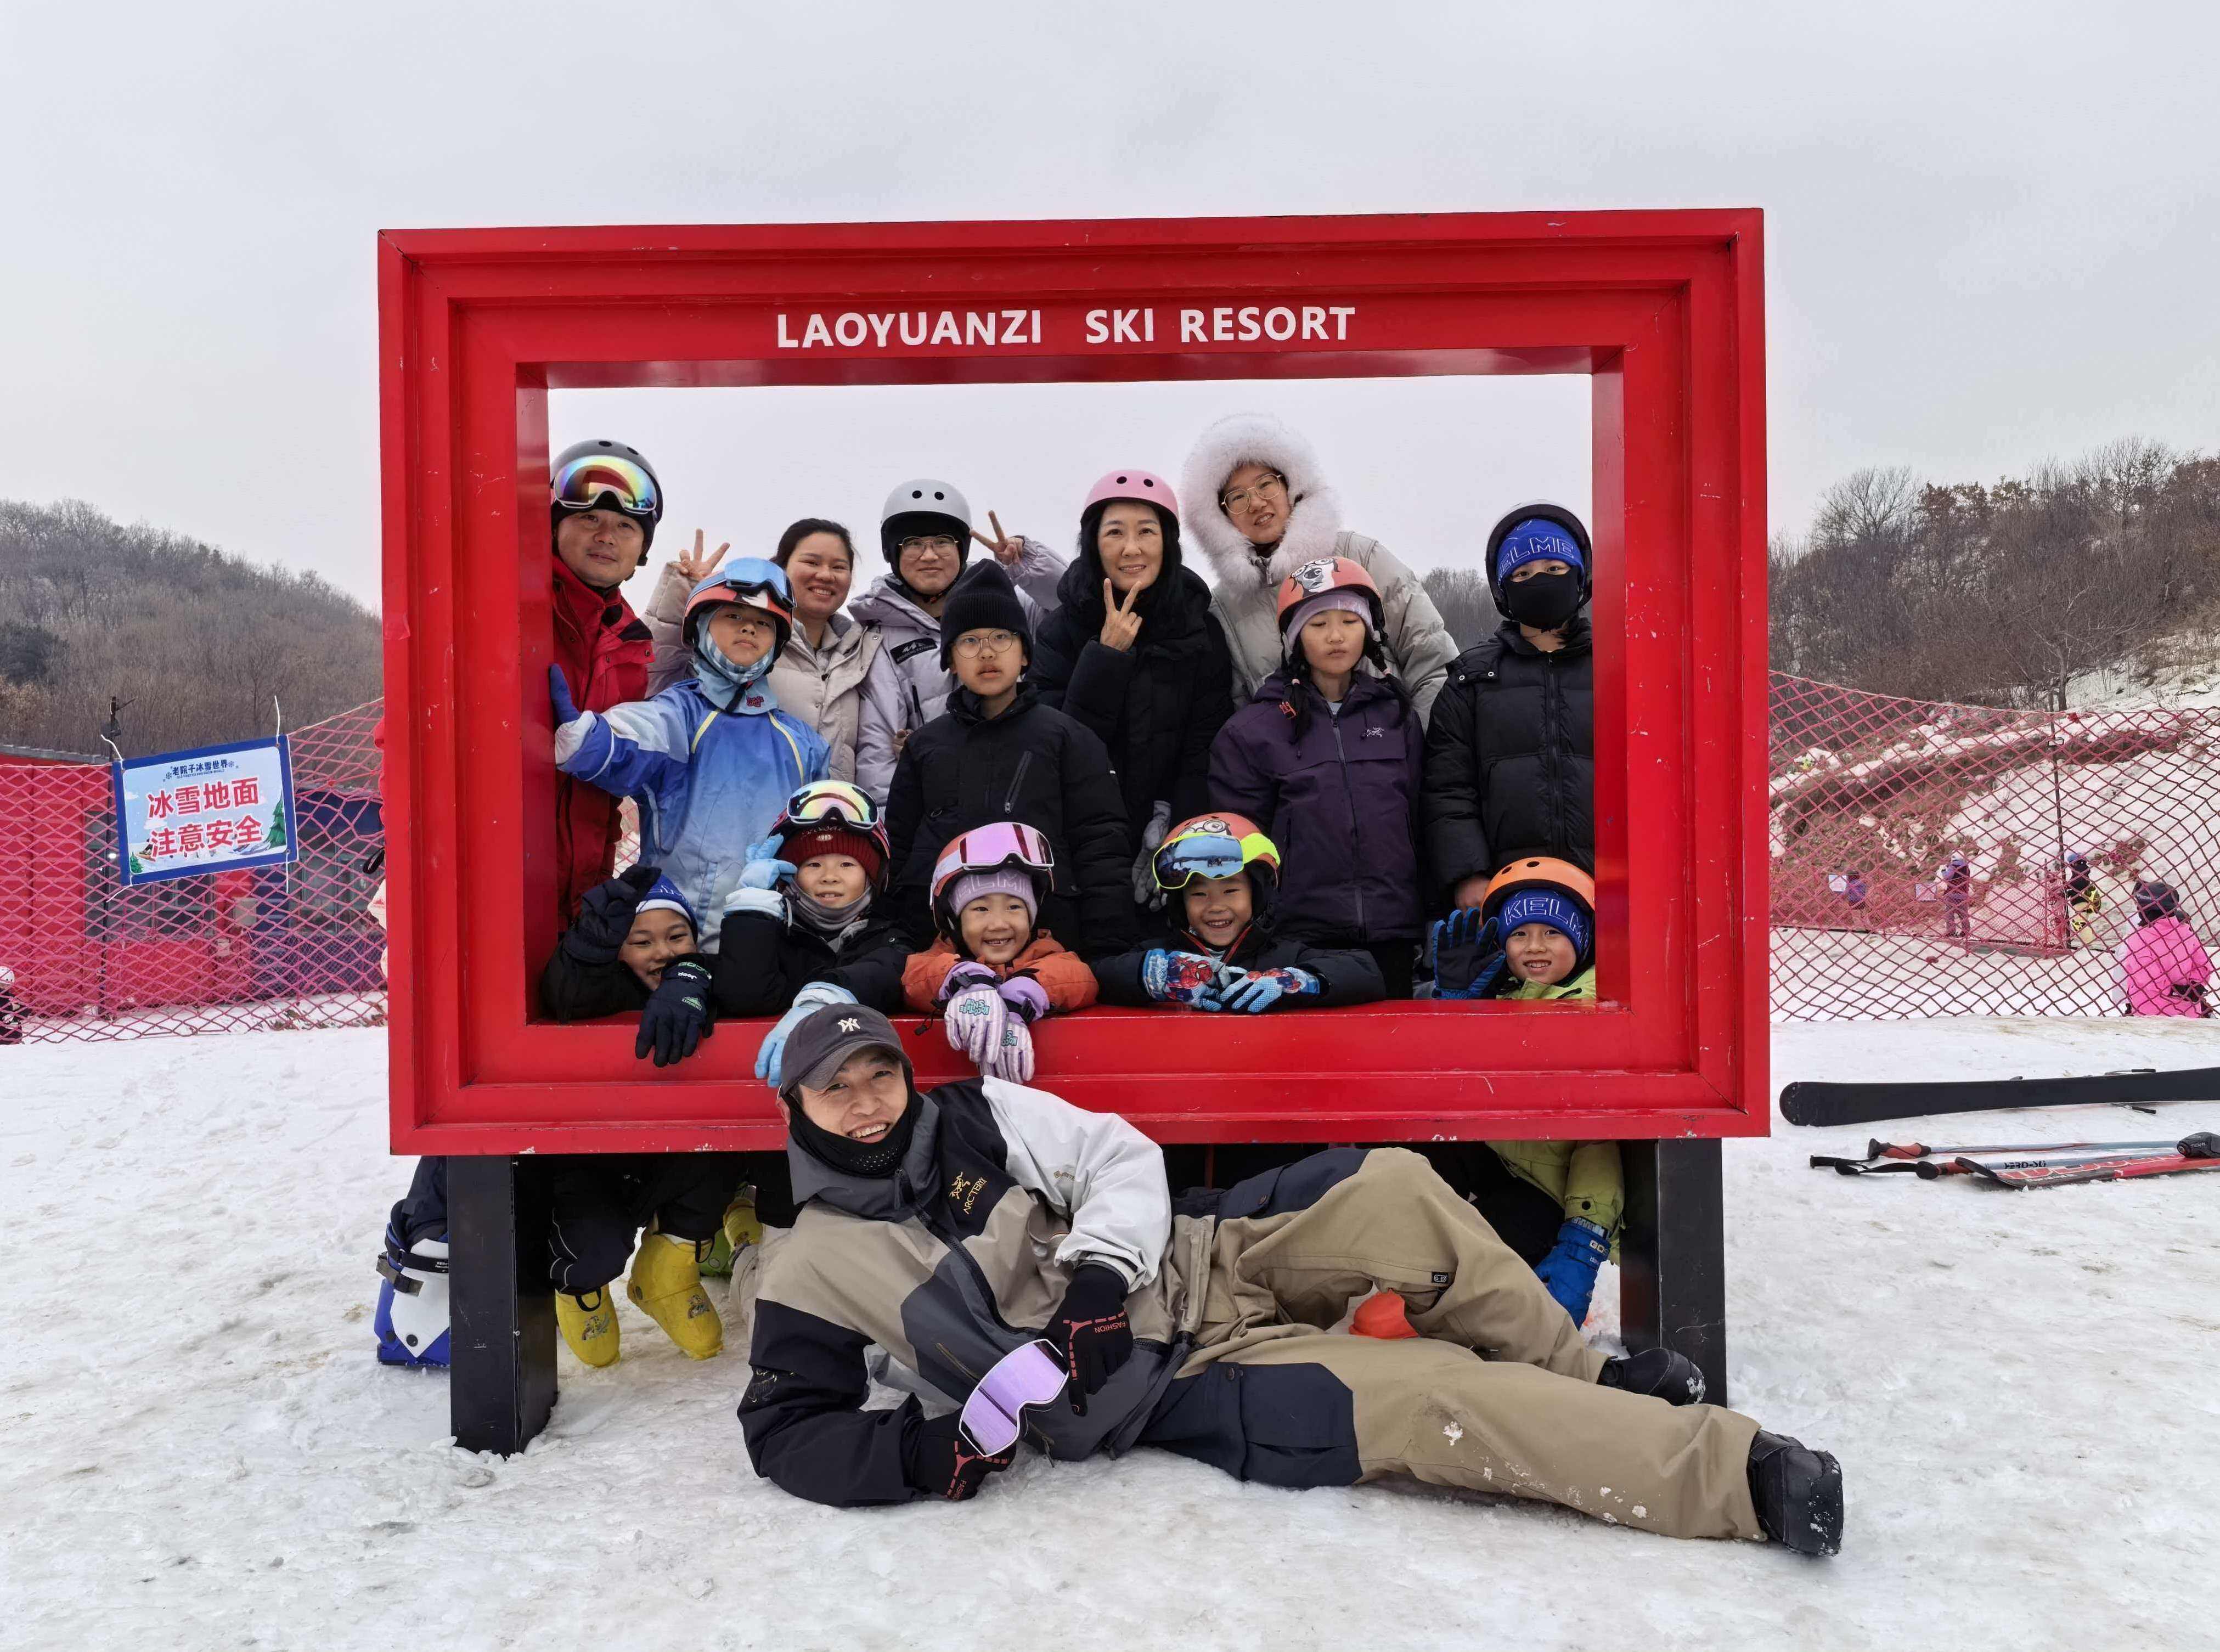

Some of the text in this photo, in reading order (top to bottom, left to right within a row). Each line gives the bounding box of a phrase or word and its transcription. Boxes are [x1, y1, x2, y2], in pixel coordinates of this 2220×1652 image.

[777, 306, 1356, 348] LAOYUANZI SKI RESORT
[1498, 535, 1574, 579] ELME
[172, 759, 228, 776] 老院子冰雪世界
[147, 776, 259, 819] 冰雪地面
[149, 814, 262, 858] 注意安全
[1094, 1321, 1126, 1333] FASHION
